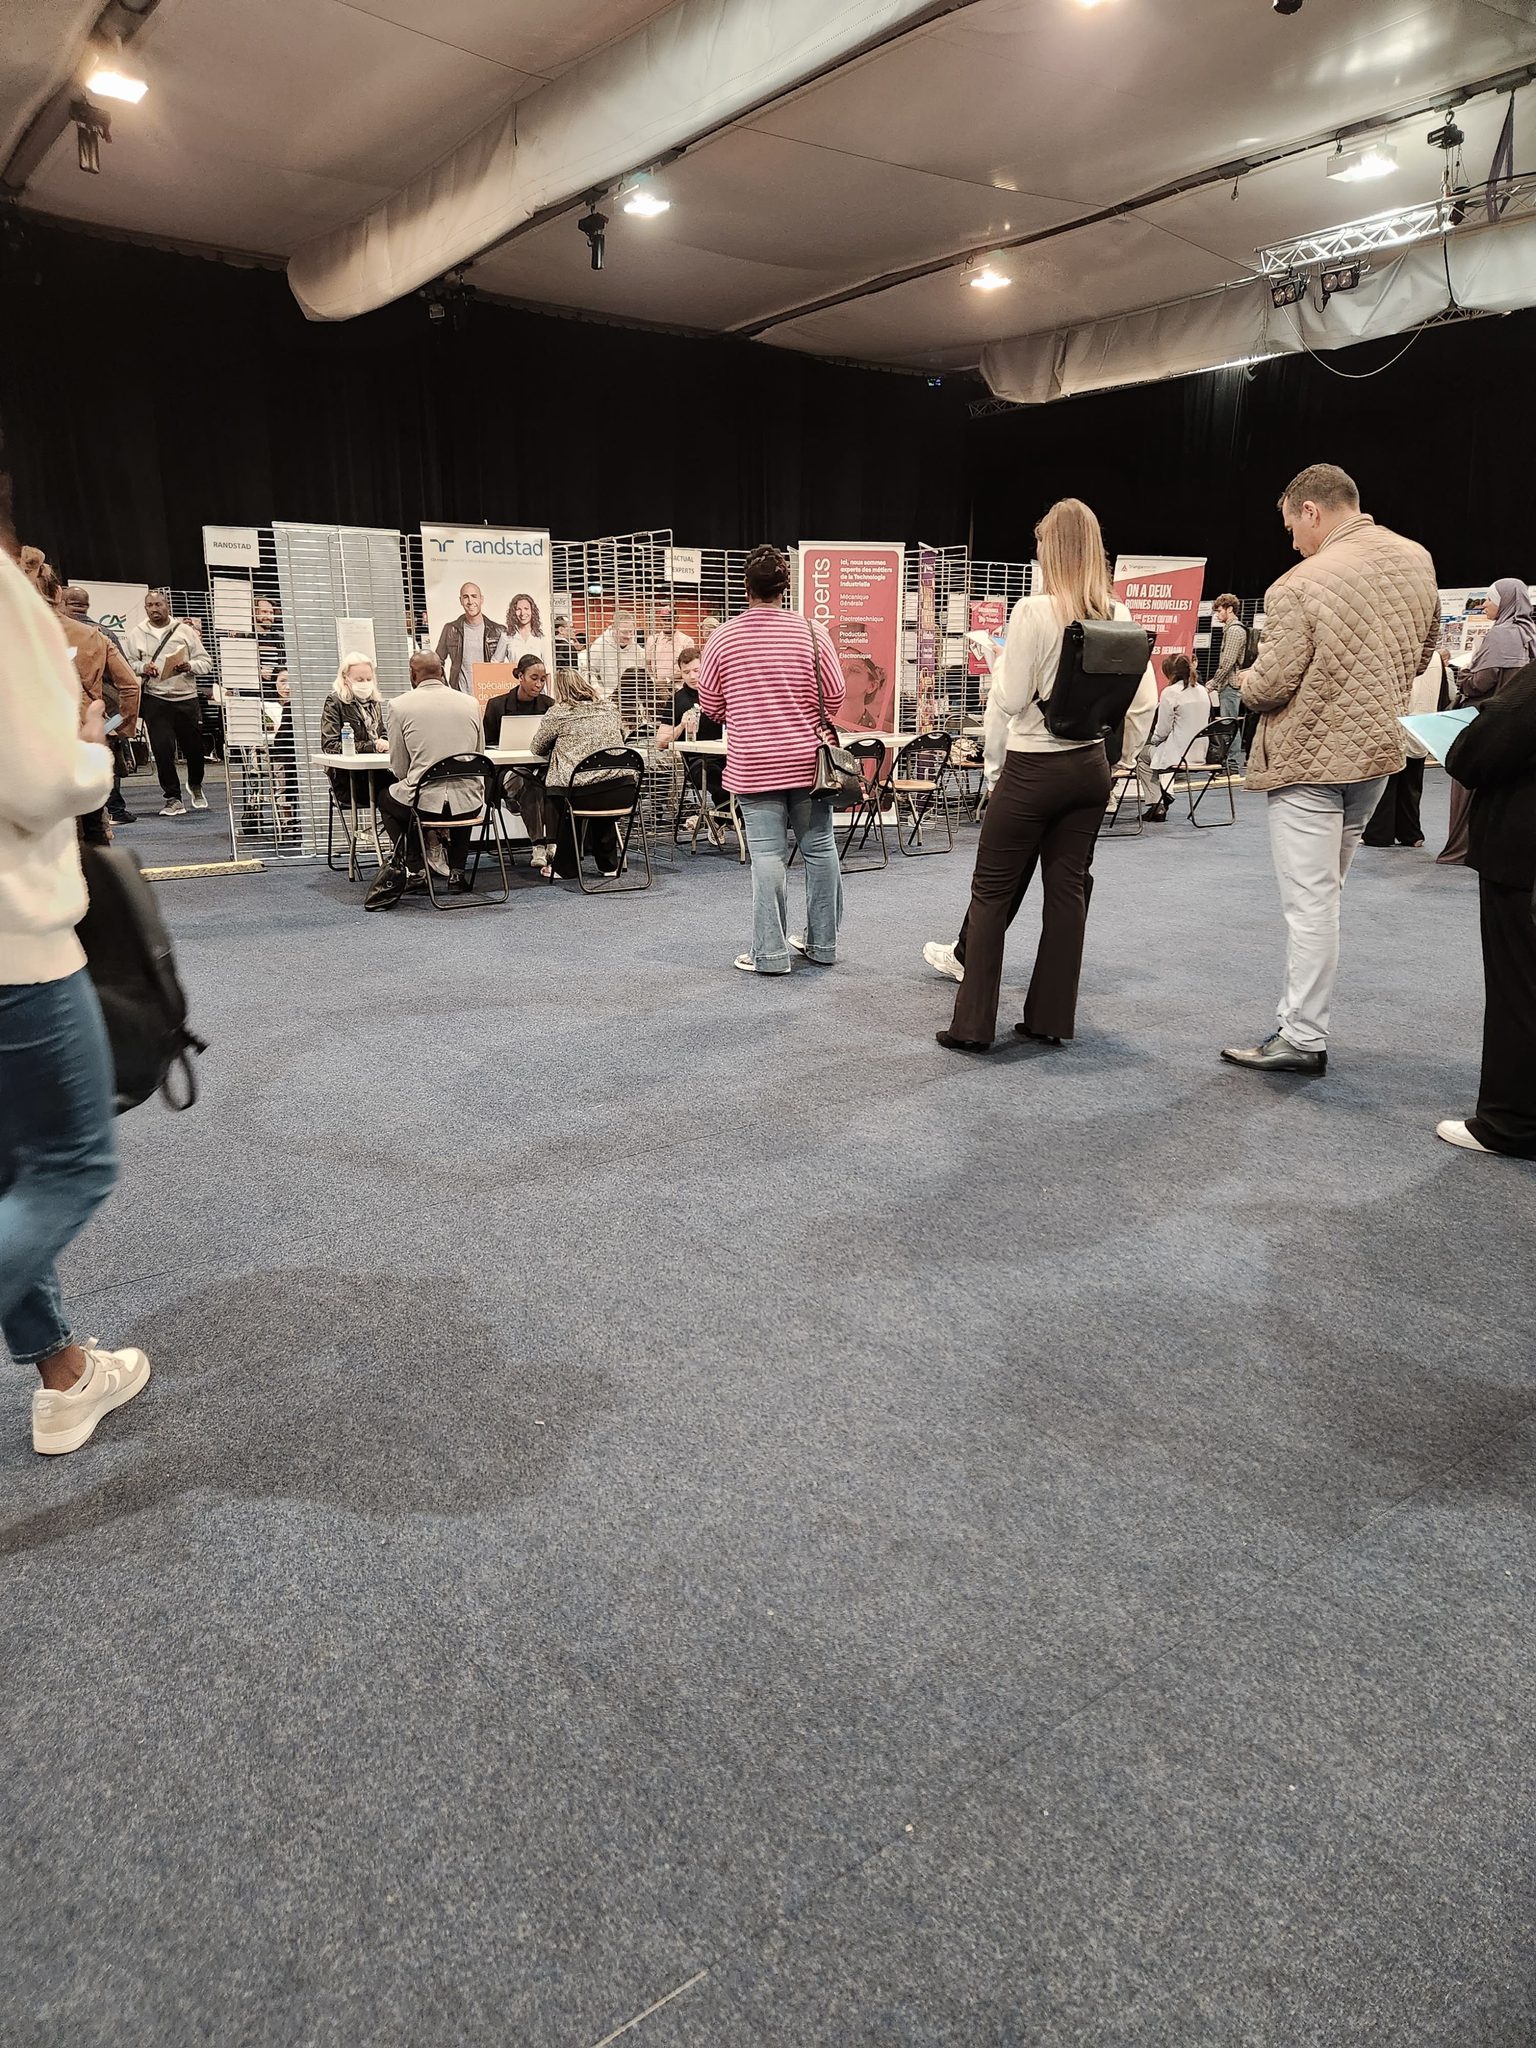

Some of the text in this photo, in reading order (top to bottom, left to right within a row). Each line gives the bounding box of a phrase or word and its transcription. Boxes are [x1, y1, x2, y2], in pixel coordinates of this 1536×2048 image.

[212, 541, 252, 550] RANDSTAD
[465, 536, 543, 556] randstad
[812, 558, 835, 632] xperts
[1126, 583, 1172, 598] ON A DEUX
[1151, 600, 1189, 610] NOUVELLES
